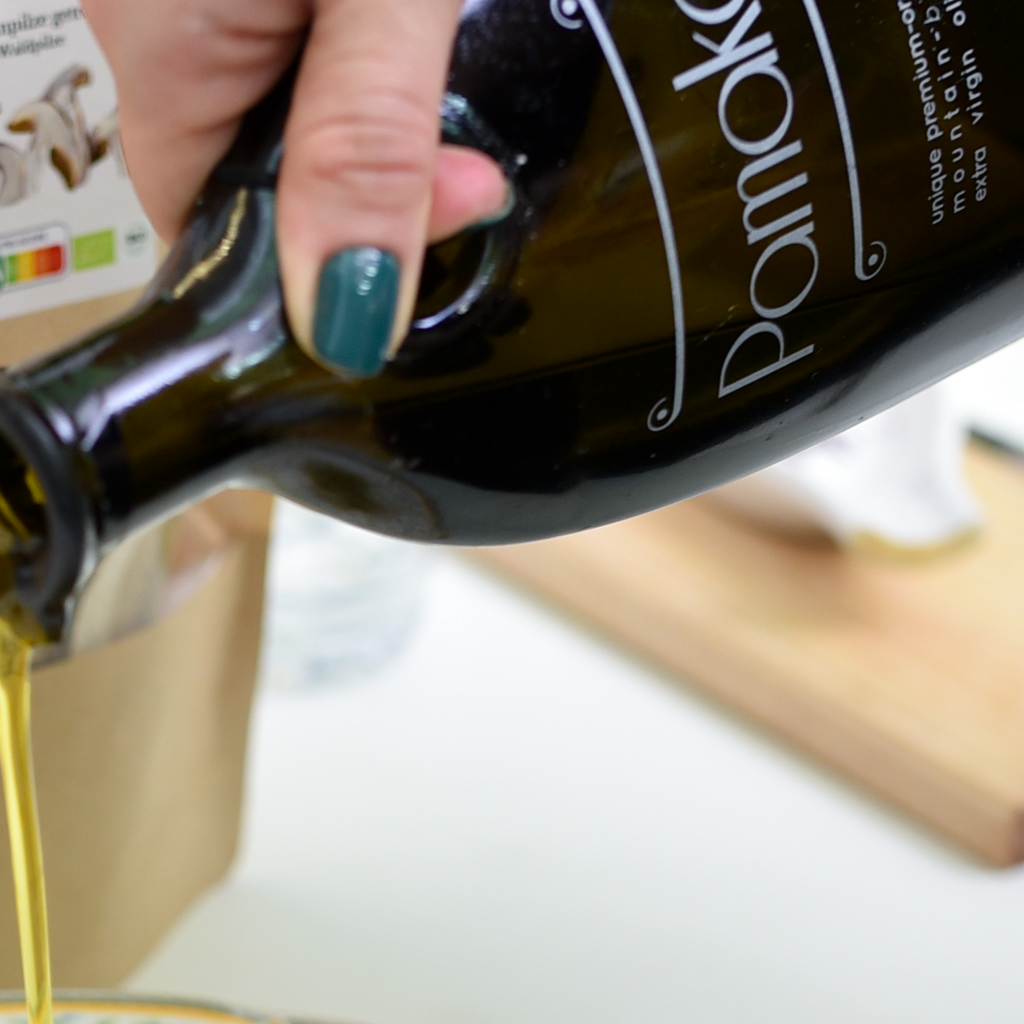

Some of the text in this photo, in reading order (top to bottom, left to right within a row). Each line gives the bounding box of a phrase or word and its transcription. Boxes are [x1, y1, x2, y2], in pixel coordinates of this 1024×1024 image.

[961, 48, 984, 125] virgin
[672, 0, 819, 398] Pamak
[929, 149, 948, 224] unique
[971, 146, 987, 201] extra
